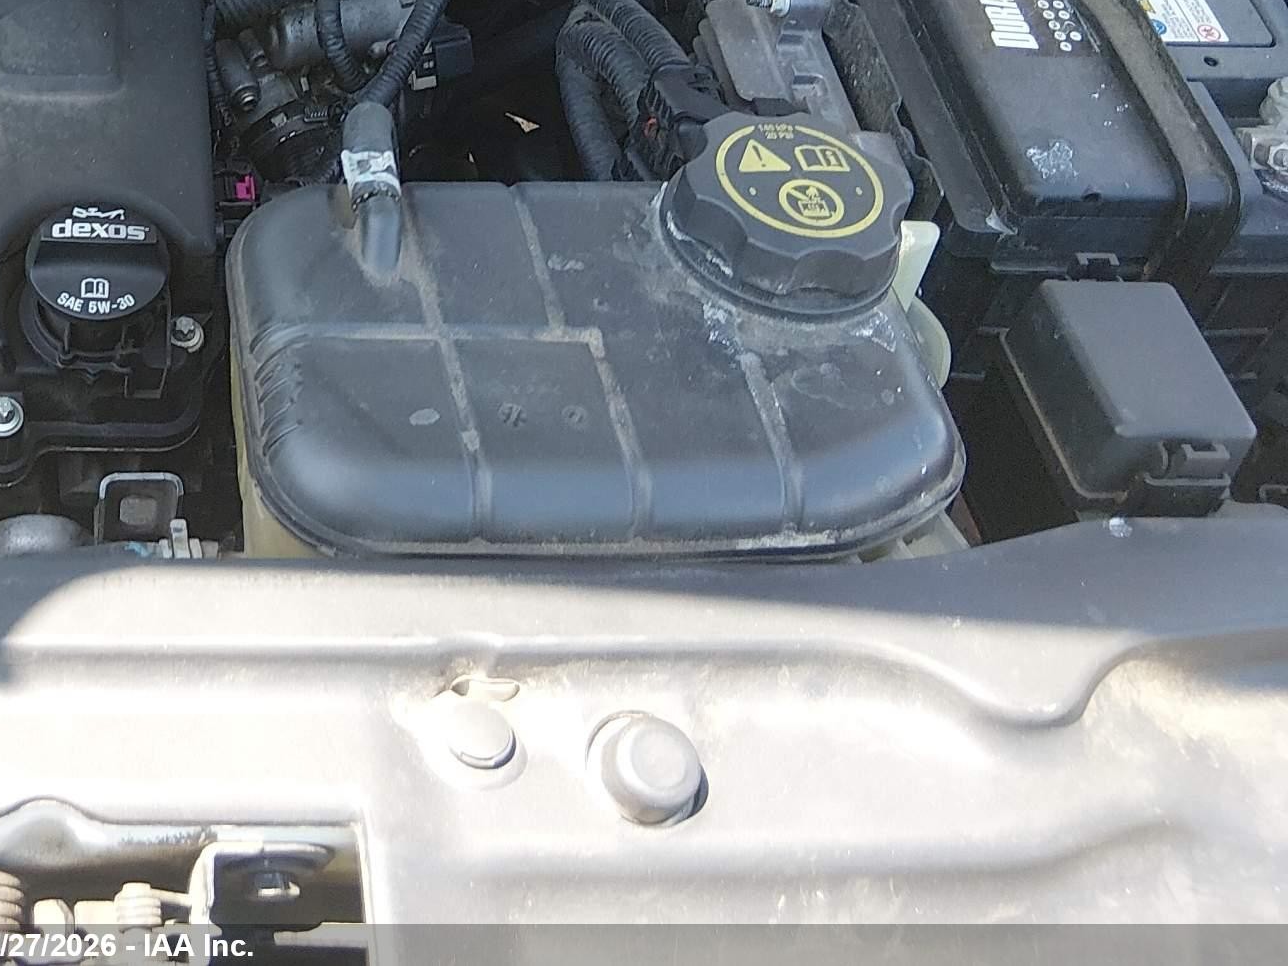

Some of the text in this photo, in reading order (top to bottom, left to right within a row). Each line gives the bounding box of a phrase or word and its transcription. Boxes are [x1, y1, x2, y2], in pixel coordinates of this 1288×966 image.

[52, 218, 145, 241] dexos
[57, 292, 136, 314] SAE 5W-30
